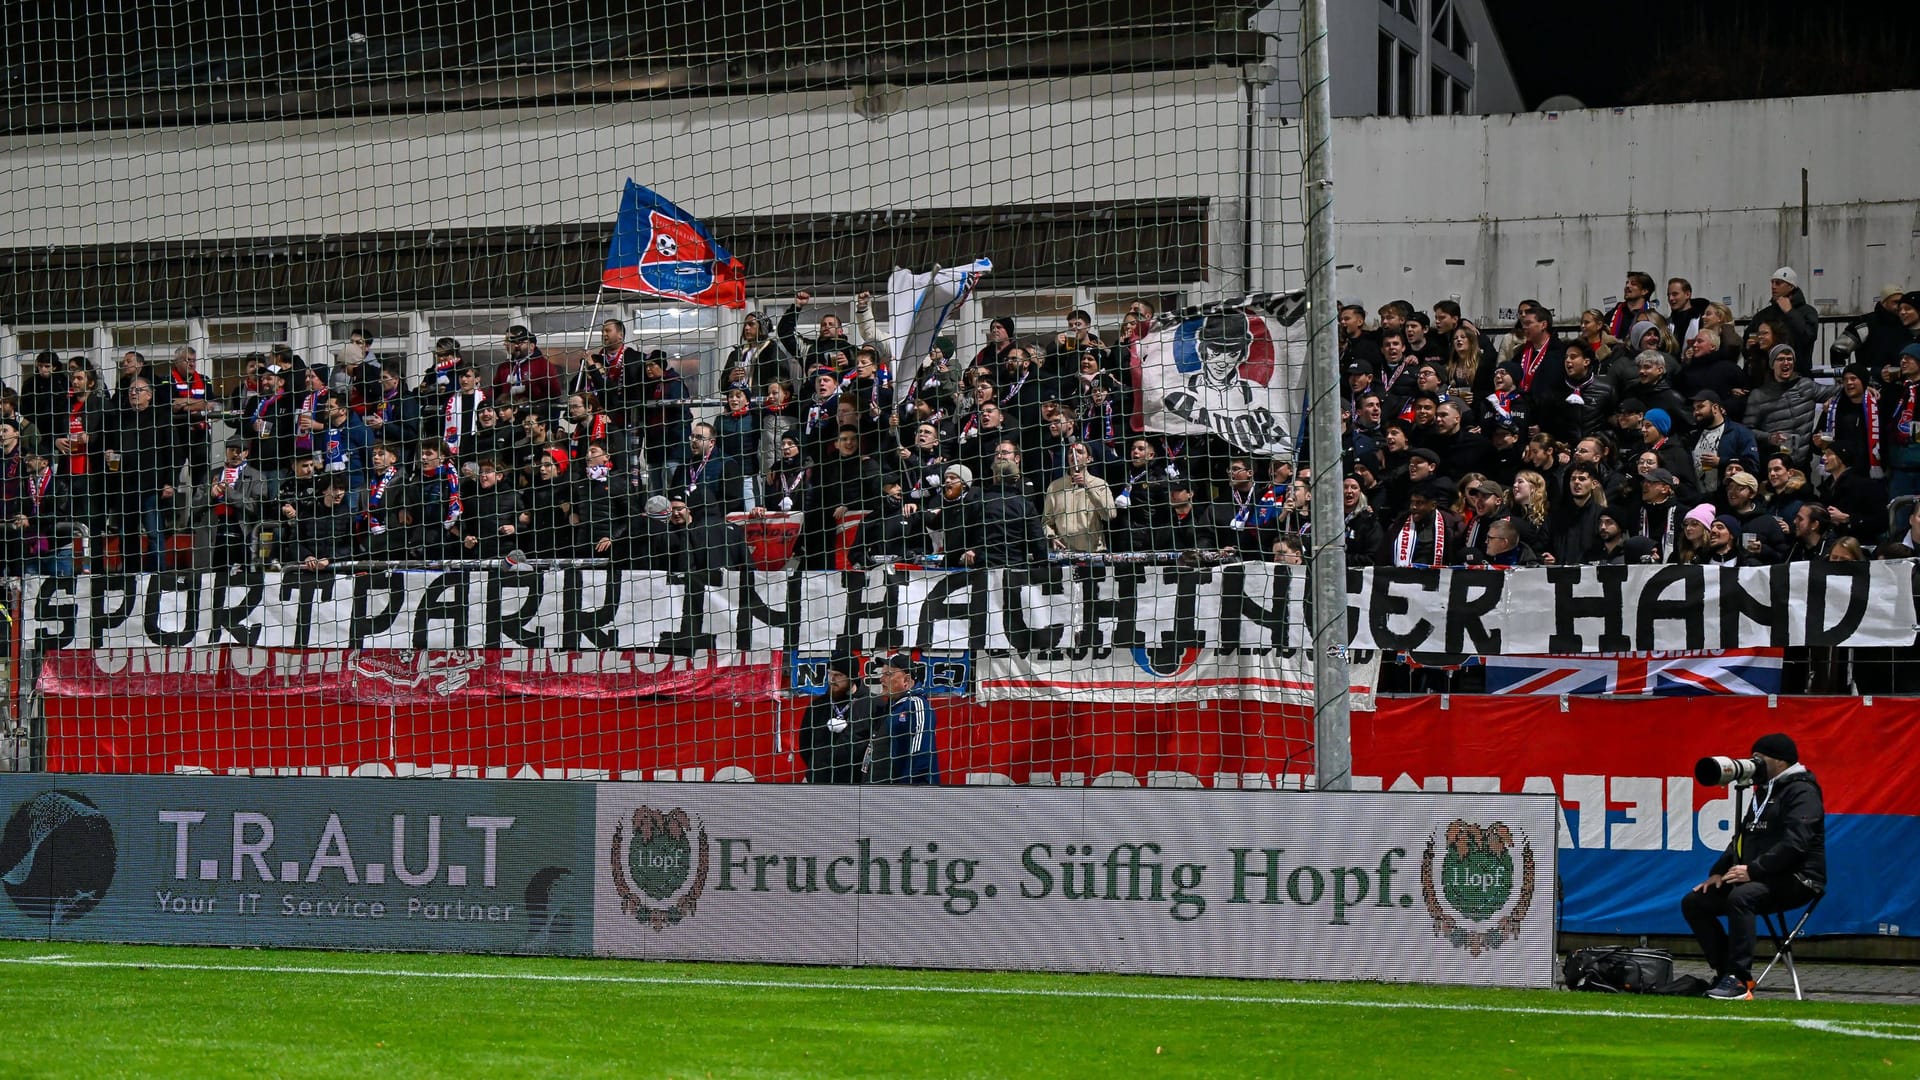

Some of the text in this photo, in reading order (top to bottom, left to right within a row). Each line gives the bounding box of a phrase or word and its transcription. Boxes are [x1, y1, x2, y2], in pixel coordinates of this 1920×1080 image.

[35, 570, 621, 649] SPORTPARK
[658, 569, 802, 651] IN
[1547, 560, 1870, 653] HAND
[159, 810, 516, 887] T.R.A.U.T
[633, 848, 684, 873] Hopf
[714, 837, 1414, 926] Fruchtig. Süffig Hopf.
[1448, 866, 1505, 892] Hopf
[157, 891, 515, 922] Your IT Service Partner
